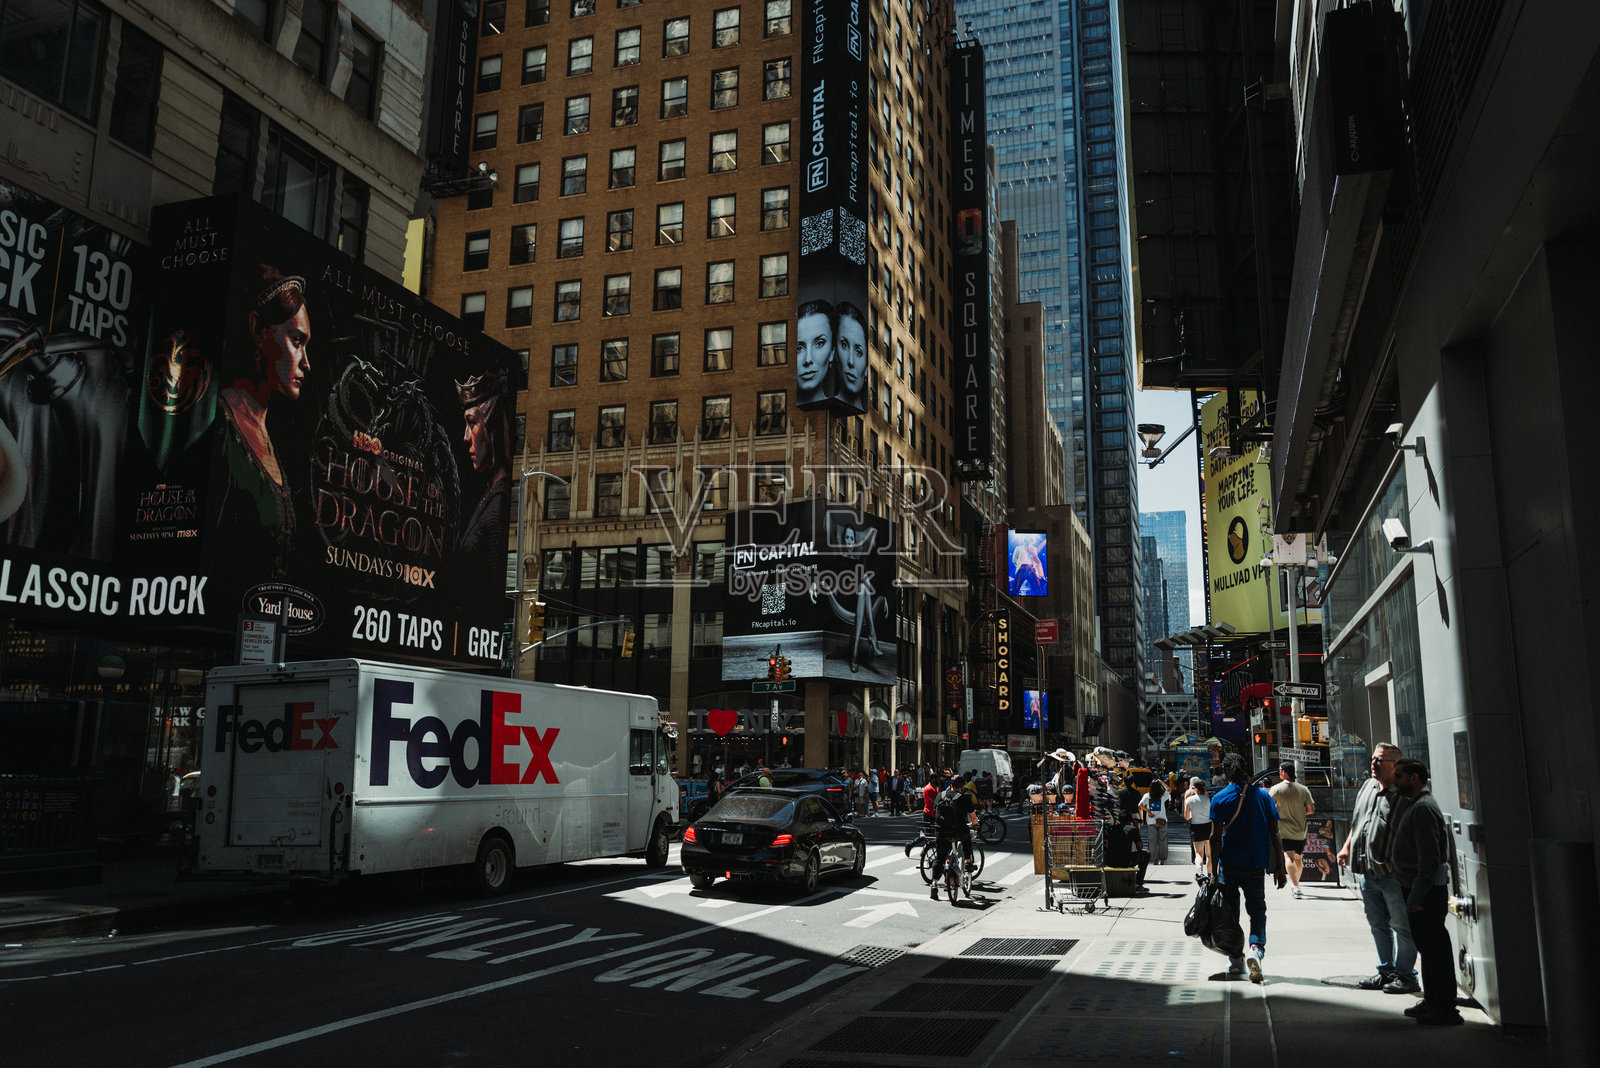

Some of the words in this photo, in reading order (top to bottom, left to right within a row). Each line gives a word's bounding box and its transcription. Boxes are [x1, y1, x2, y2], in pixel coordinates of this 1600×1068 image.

[850, 0, 859, 26] CA
[452, 21, 469, 155] SQUARE
[812, 79, 825, 156] CAPITAL
[960, 54, 975, 192] TIMES
[848, 80, 861, 203] FNcapital.io
[175, 232, 219, 251] MUST
[183, 216, 212, 234] ALL
[73, 244, 133, 312] 130
[161, 247, 228, 270] CHOOSE
[68, 294, 129, 348] TAPS
[320, 264, 353, 293] ALL
[361, 284, 406, 320] MUST
[411, 313, 473, 356] CHOOSE
[963, 272, 978, 452] SQUARE
[352, 429, 384, 456] HBO
[383, 449, 425, 473] ORIGINAL
[1210, 457, 1227, 478] DATA
[140, 489, 183, 507] HOUSE
[324, 446, 419, 510] HOUSE
[1218, 462, 1255, 497] MAPPING
[136, 504, 198, 523] DRAGON
[422, 498, 444, 518] THE
[1217, 489, 1237, 513] YOUR
[130, 531, 160, 541] SUNDAYS
[176, 529, 199, 539] max
[314, 487, 446, 559] DRAGON
[325, 545, 394, 578] SUNDAYS
[737, 549, 754, 565] FN
[759, 541, 818, 562] CAPITAL
[128, 575, 209, 617] ROCK
[1213, 567, 1251, 594] MULLVAD
[1252, 563, 1266, 581] VP
[258, 596, 282, 616] Yard
[751, 618, 797, 629] FNcapital.io
[352, 604, 391, 643] 260
[397, 612, 443, 651] TAPS
[997, 618, 1010, 711] SHOCARD
[1300, 687, 1317, 695] WAY
[215, 701, 341, 754] FedEx
[369, 678, 561, 789] FedEx
[290, 915, 646, 965] ONLY
[593, 948, 872, 1003] ONLY
